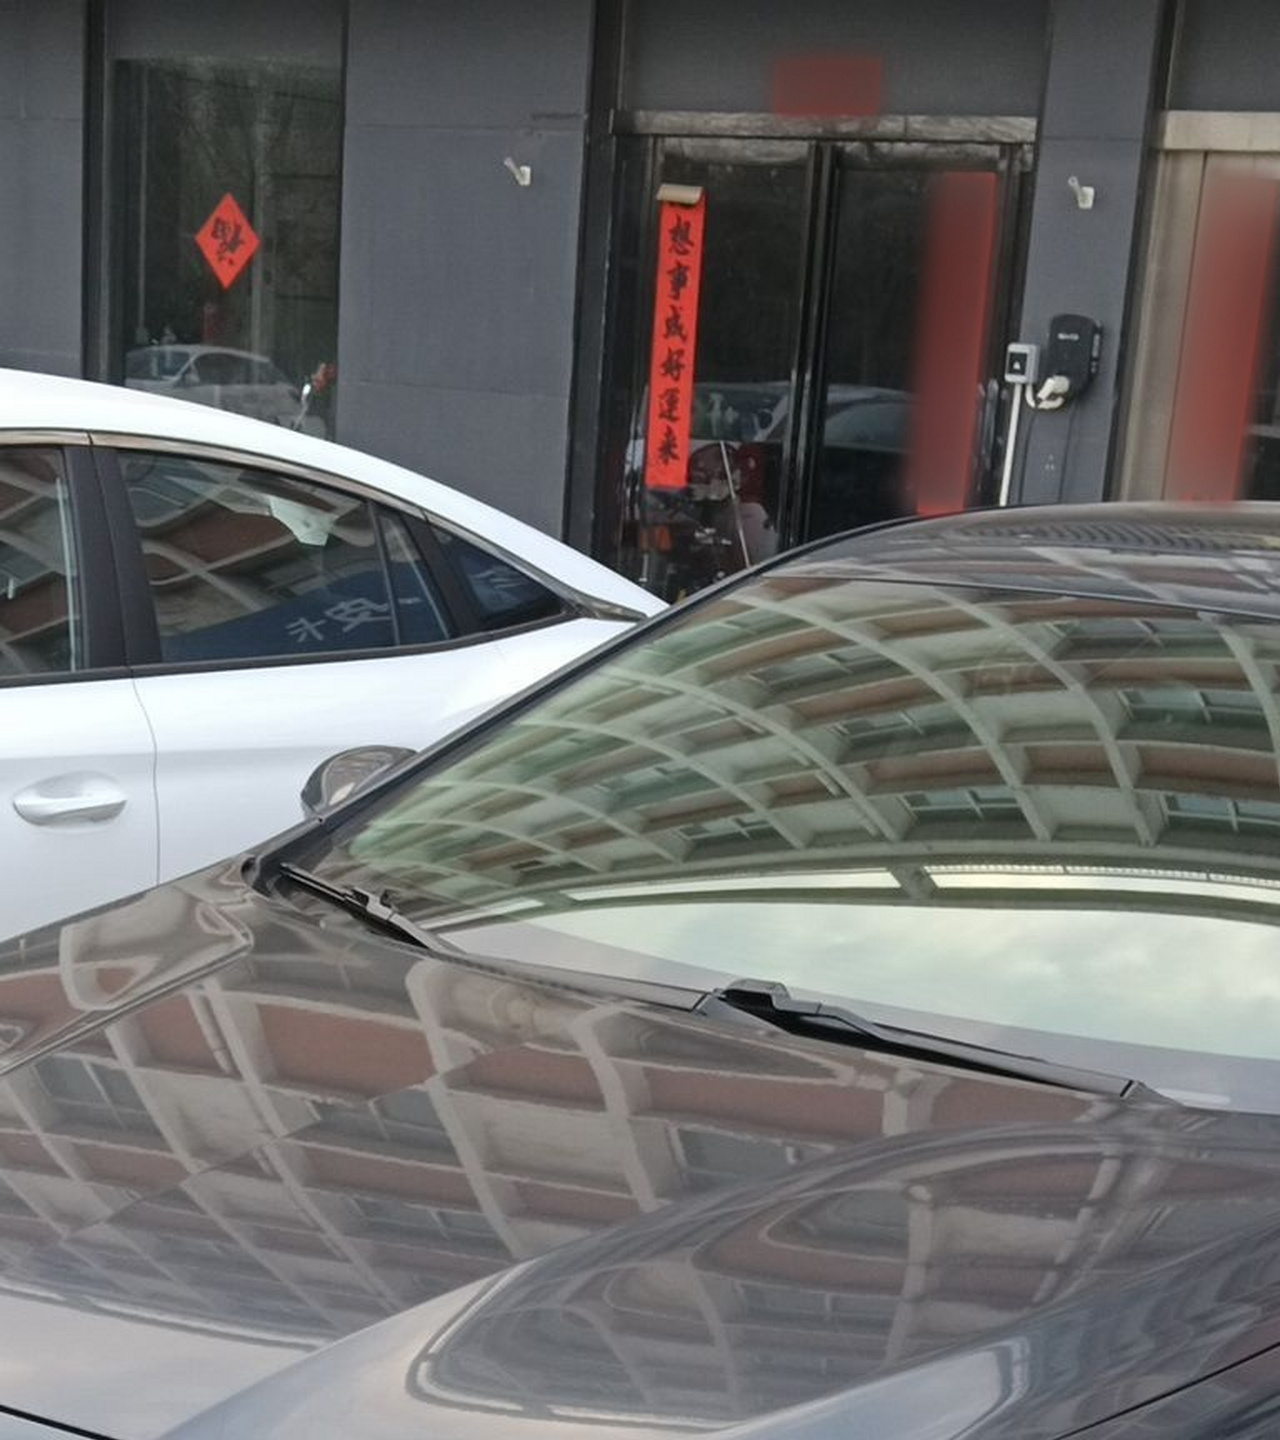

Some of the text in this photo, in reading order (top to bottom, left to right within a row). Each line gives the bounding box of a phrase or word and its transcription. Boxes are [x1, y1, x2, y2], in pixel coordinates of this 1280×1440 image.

[658, 213, 695, 466] 想事成好運来
